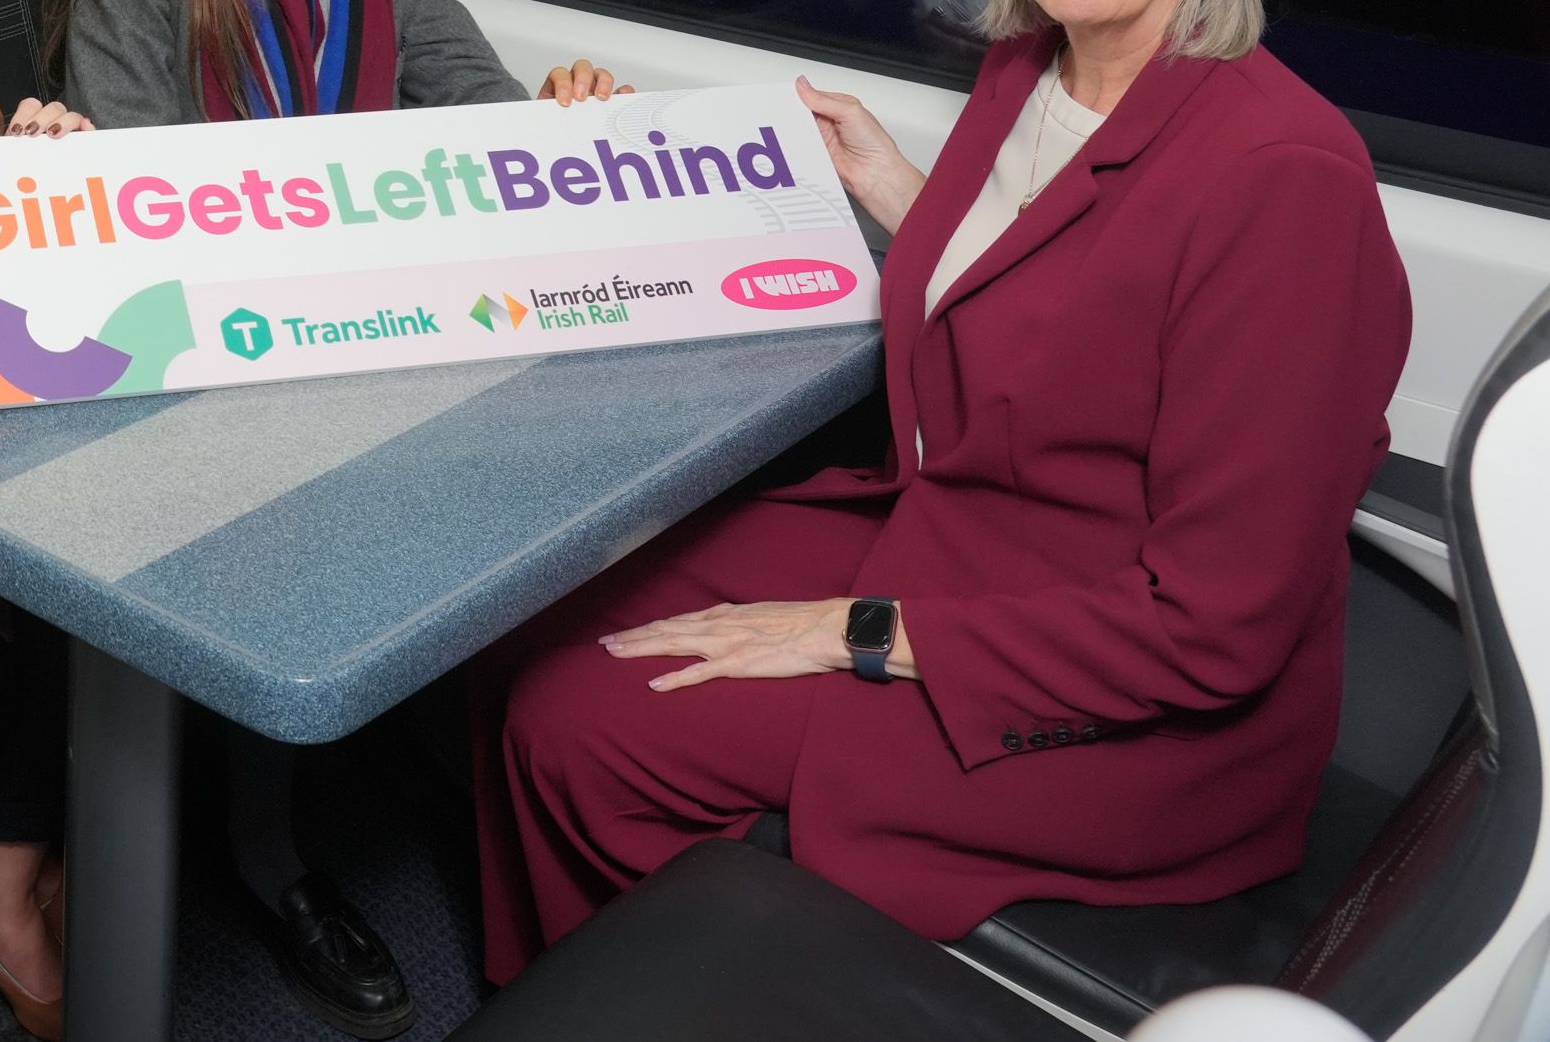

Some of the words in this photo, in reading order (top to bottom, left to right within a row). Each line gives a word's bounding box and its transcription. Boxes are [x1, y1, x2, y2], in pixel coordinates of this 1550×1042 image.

[530, 281, 610, 308] Iarnród
[611, 274, 694, 300] Éireann
[739, 277, 755, 300] I
[752, 269, 840, 297] WISH
[282, 306, 441, 346] Translink
[537, 309, 586, 329] Irish
[588, 303, 630, 325] Rail
